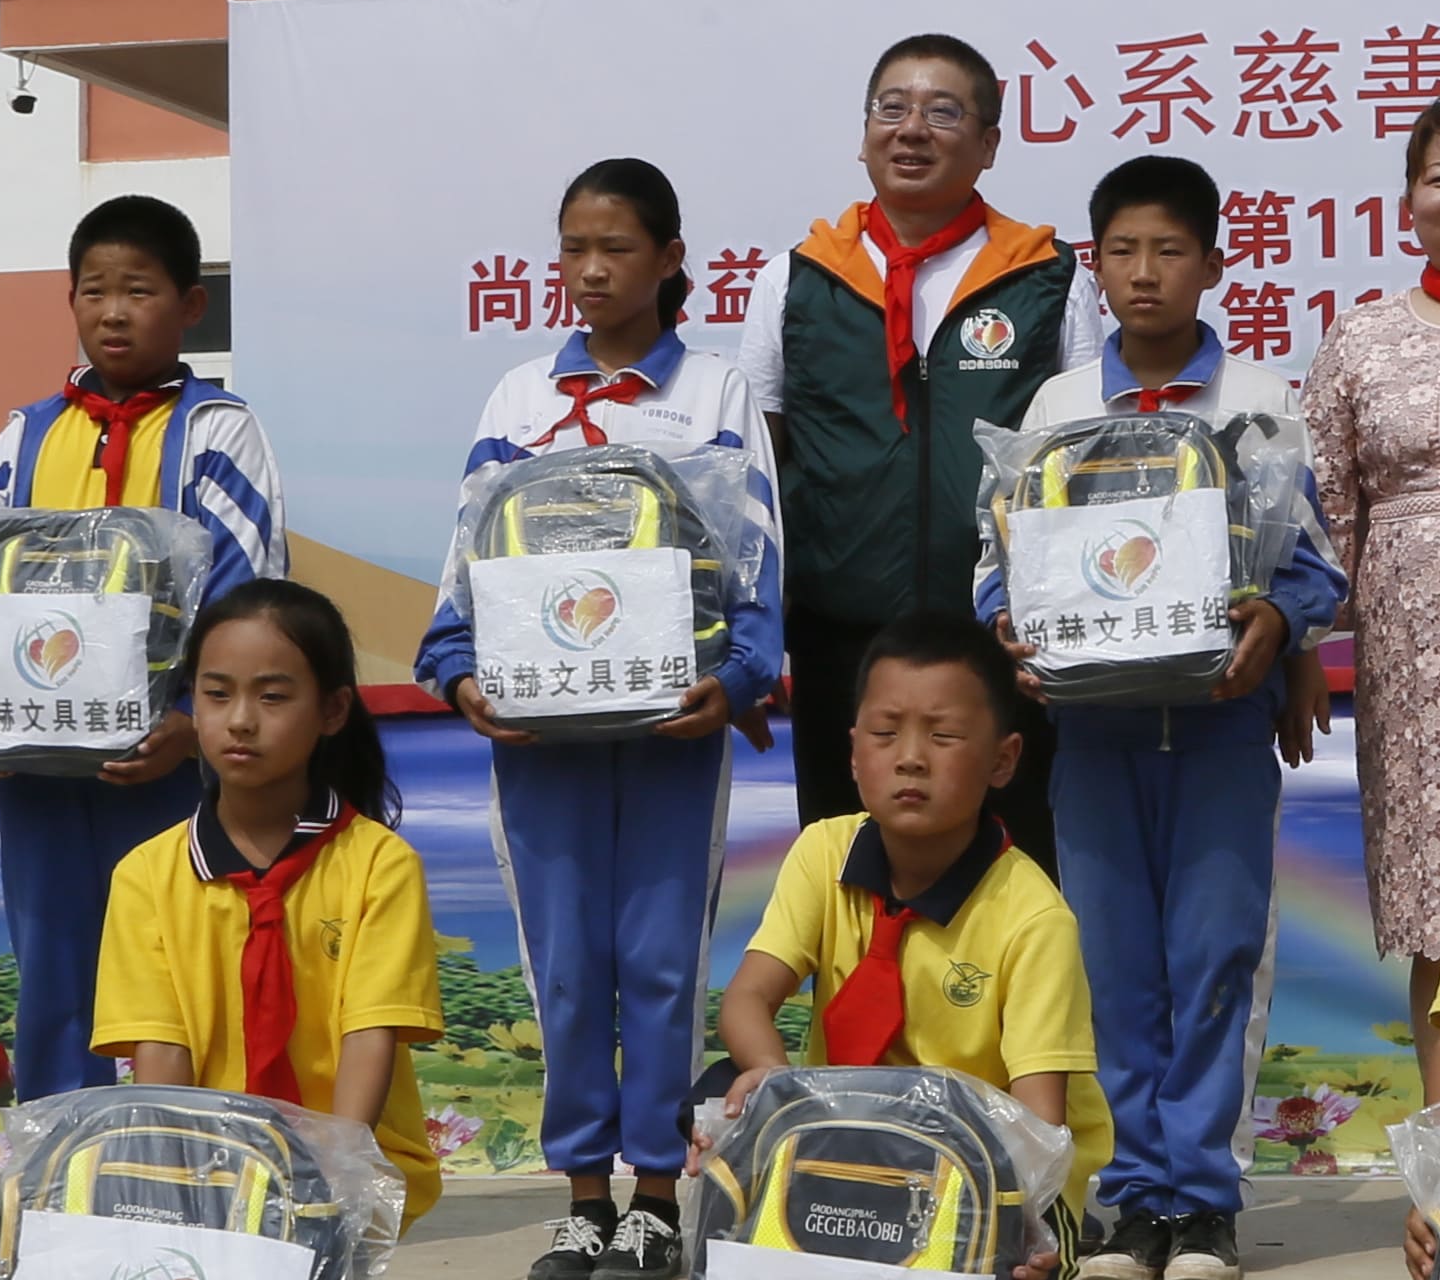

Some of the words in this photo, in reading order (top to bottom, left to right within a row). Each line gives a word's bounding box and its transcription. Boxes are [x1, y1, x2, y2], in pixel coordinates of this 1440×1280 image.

[1024, 595, 1230, 652] 尚赫文具套组
[480, 655, 692, 700] 尚赫文具套组
[805, 1213, 903, 1244] GEGEBAOBEI
